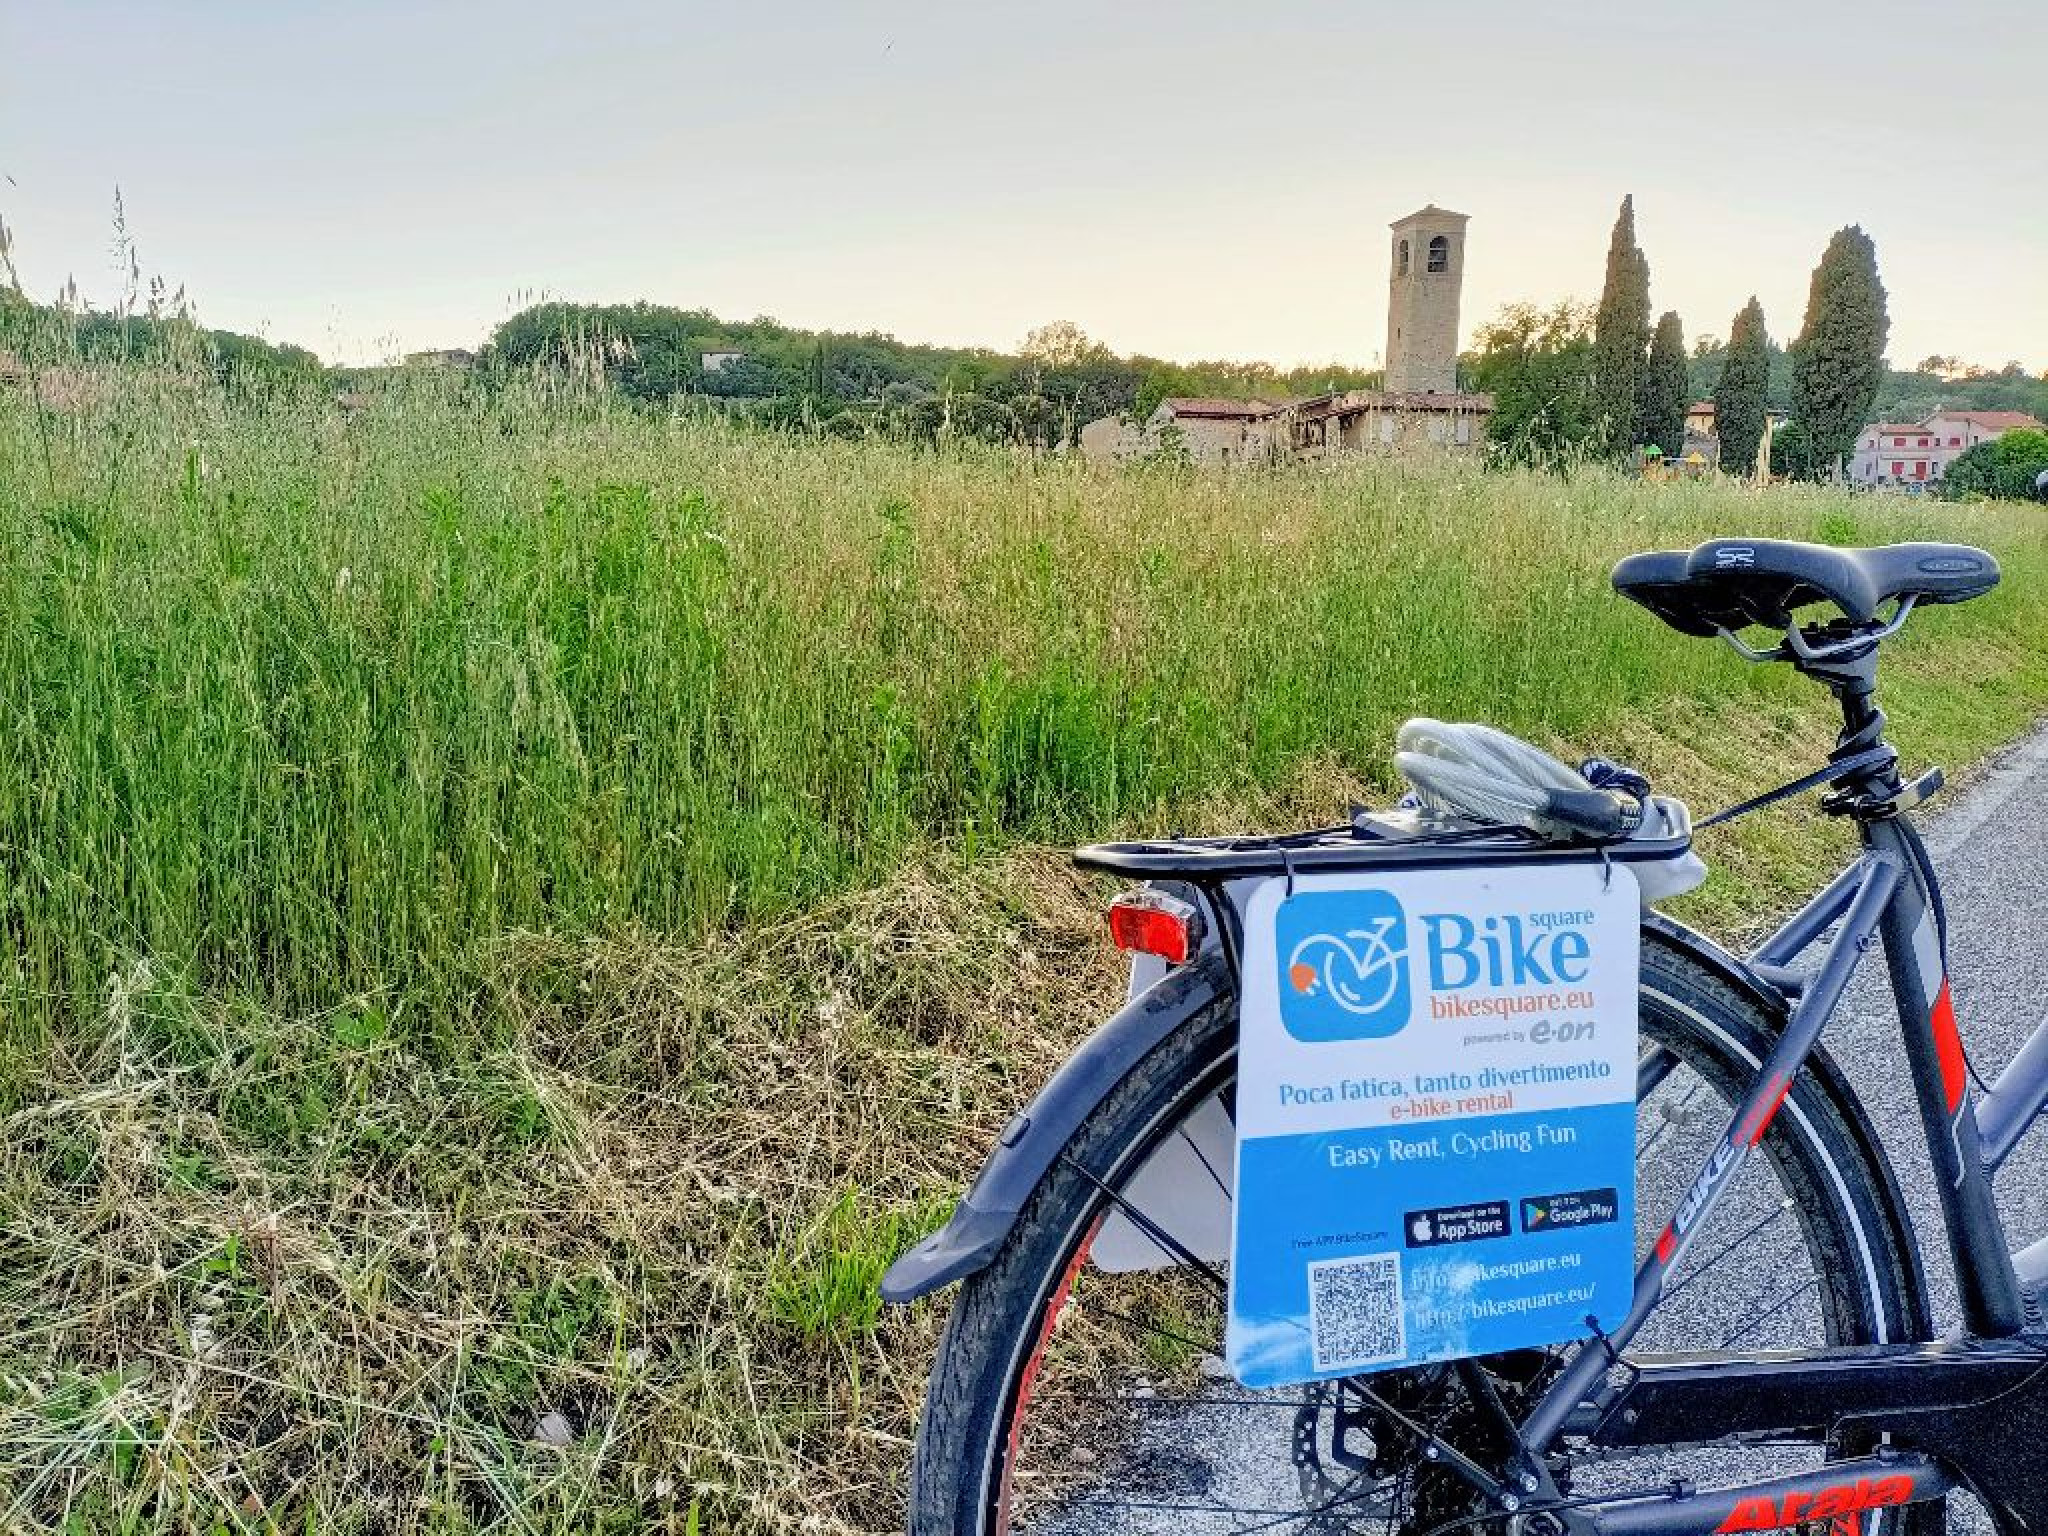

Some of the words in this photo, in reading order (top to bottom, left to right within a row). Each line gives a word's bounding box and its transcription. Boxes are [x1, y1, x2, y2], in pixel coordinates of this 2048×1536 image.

[1530, 910, 1594, 930] square
[1419, 914, 1590, 991] Bike
[1430, 991, 1594, 1020] bikesquare.eu
[1279, 1083, 1334, 1106] Poca
[1340, 1079, 1409, 1101] fatica,
[1414, 1073, 1472, 1095] tanto
[1477, 1059, 1611, 1089] divertimento
[1391, 1097, 1452, 1121] e-bike
[1456, 1089, 1513, 1114] rental
[1328, 1144, 1382, 1169] Easy
[1388, 1136, 1446, 1163] Rent,
[1451, 1127, 1533, 1160] Cycling
[1537, 1122, 1577, 1146] Fun
[1675, 1136, 1736, 1235] BIKE
[1550, 1208, 1590, 1223] Google
[1591, 1202, 1614, 1219] Play
[1438, 1222, 1467, 1241] App
[1467, 1217, 1503, 1238] Store
